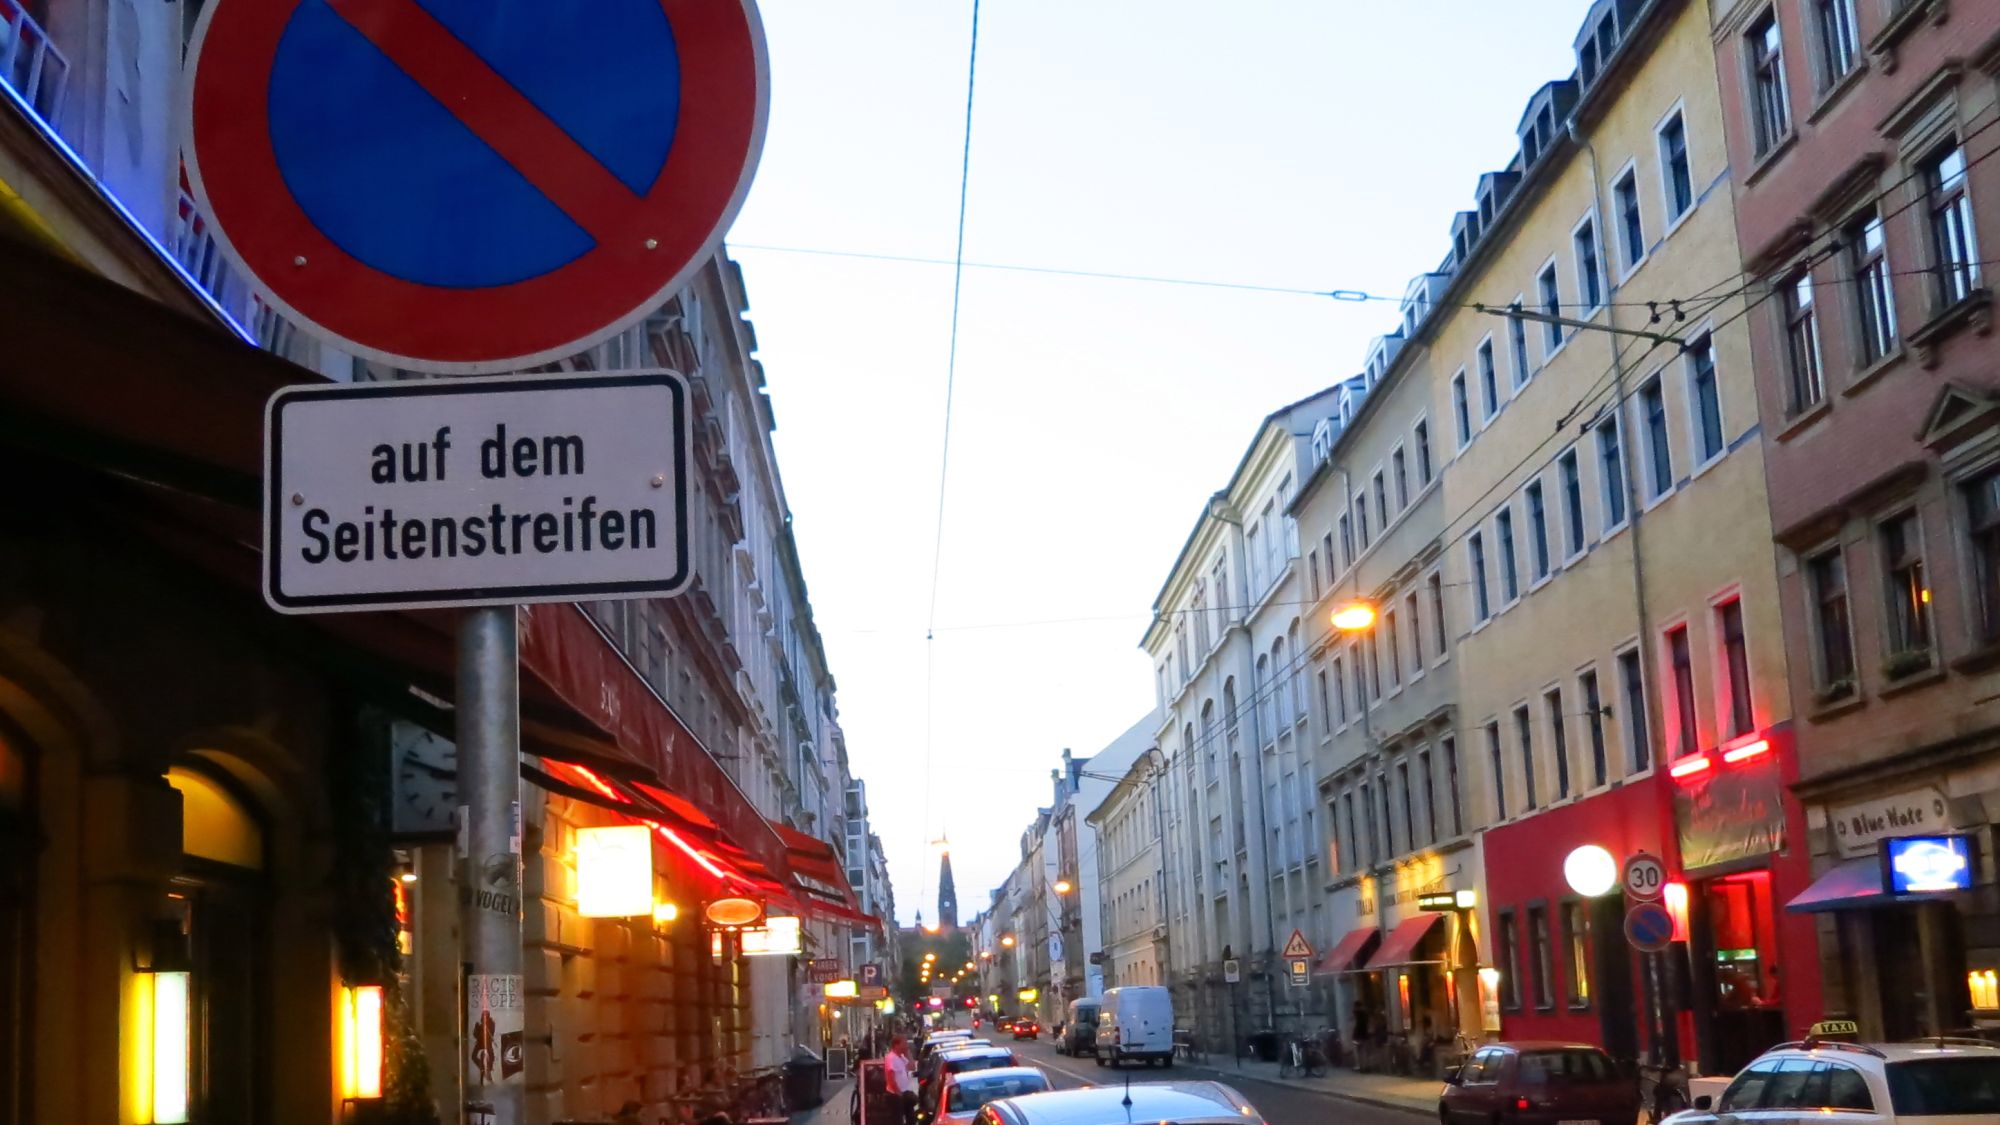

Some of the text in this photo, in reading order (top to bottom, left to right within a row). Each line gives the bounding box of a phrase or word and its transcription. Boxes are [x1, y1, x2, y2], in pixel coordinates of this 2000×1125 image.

[371, 423, 584, 484] auf dem
[302, 495, 656, 564] Seitenstreifen
[1852, 811, 1885, 836] Blue
[1632, 866, 1659, 888] 30
[864, 966, 877, 984] P
[1823, 1023, 1854, 1033] TAXI
